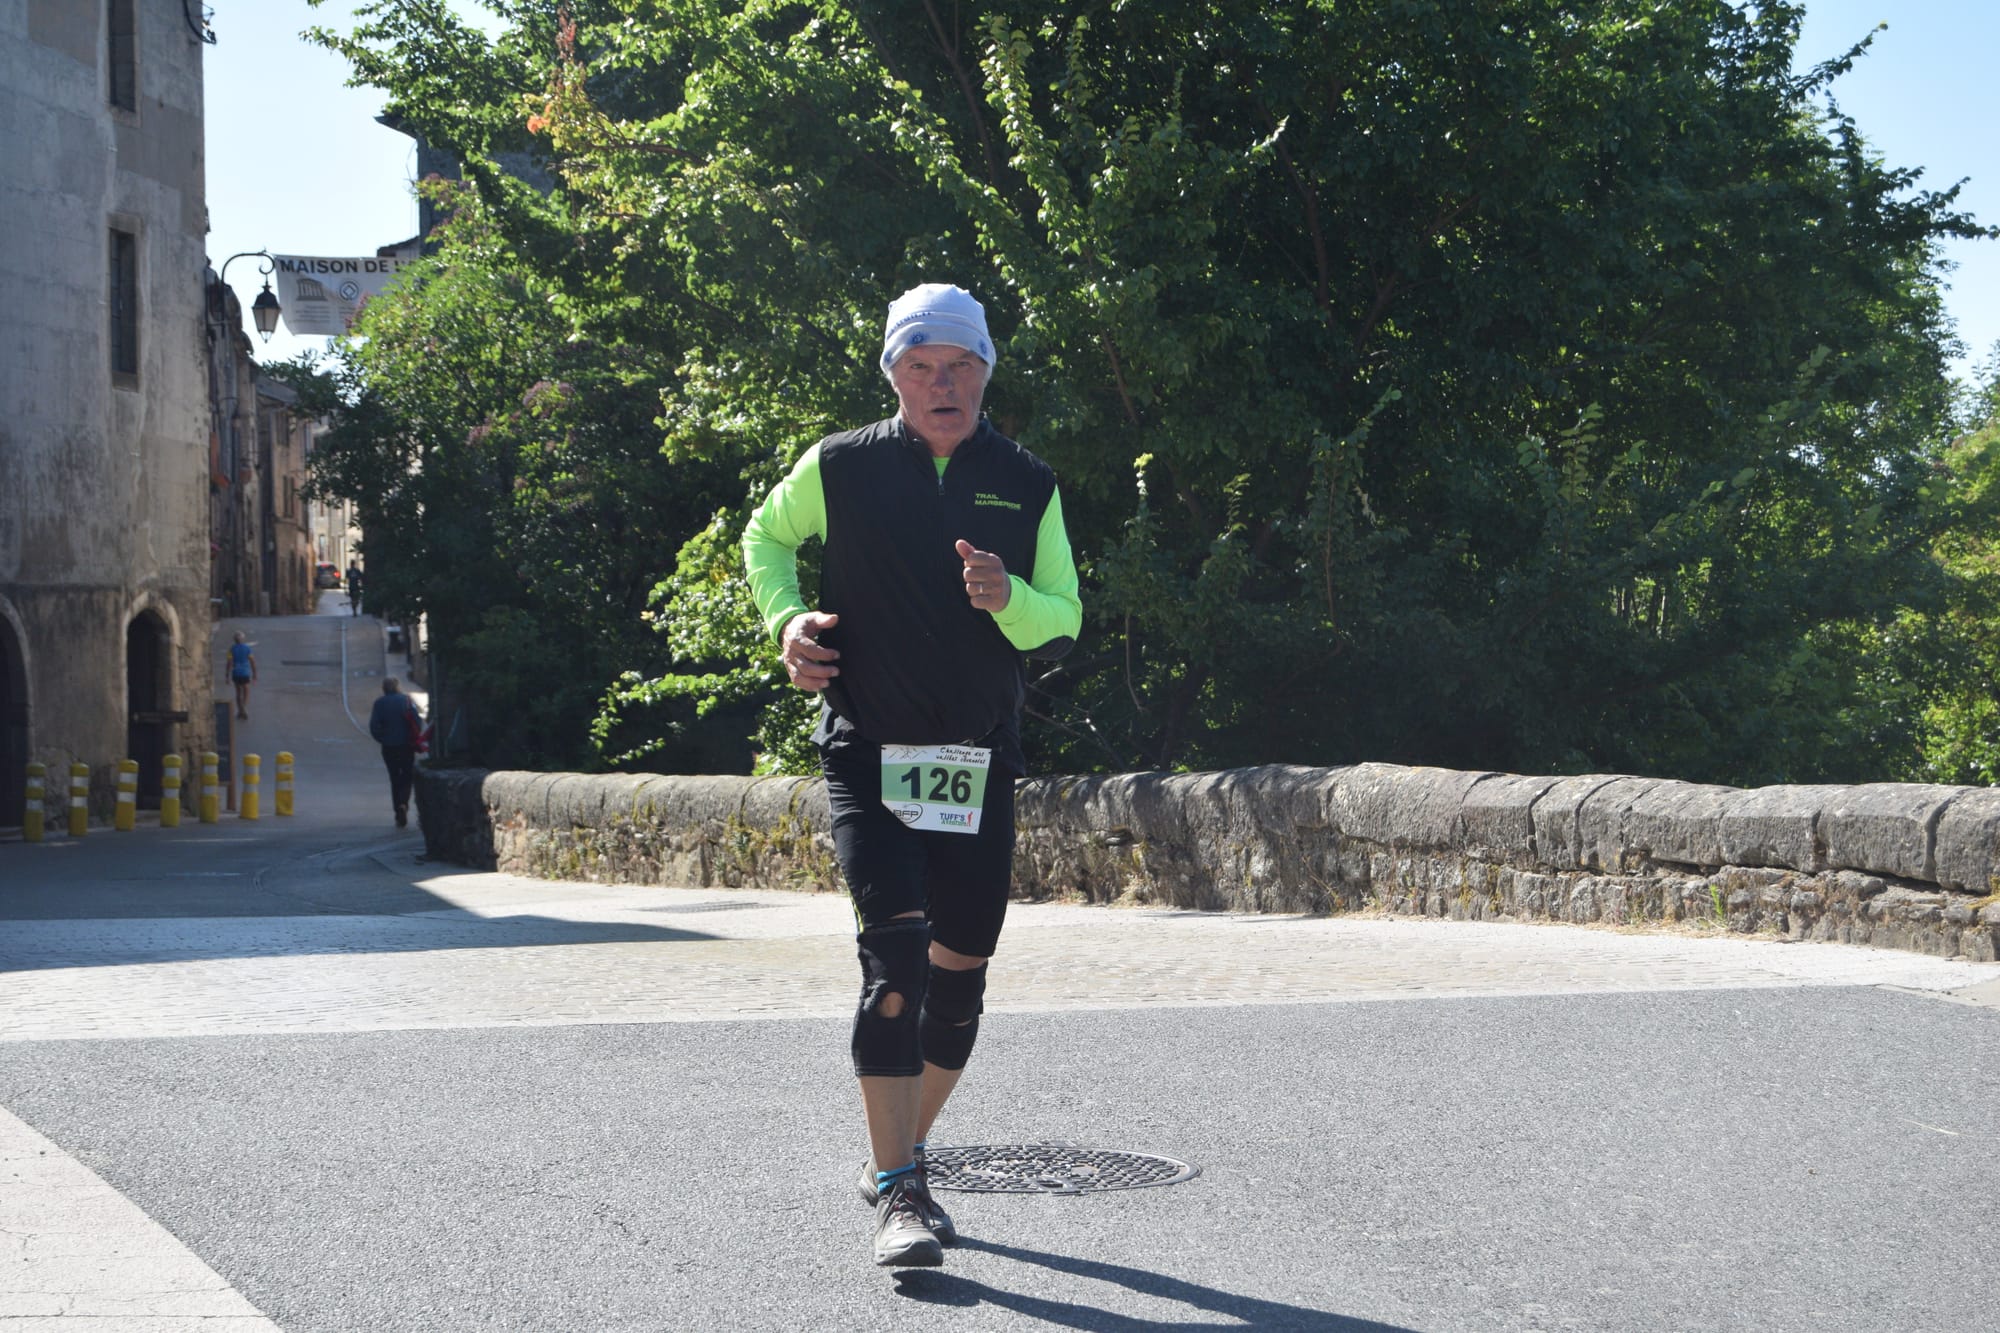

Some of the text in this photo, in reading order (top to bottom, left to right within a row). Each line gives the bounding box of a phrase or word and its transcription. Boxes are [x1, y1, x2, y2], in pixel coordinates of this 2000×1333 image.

[279, 259, 358, 274] MAISON
[365, 259, 390, 273] DE
[901, 766, 973, 804] 126
